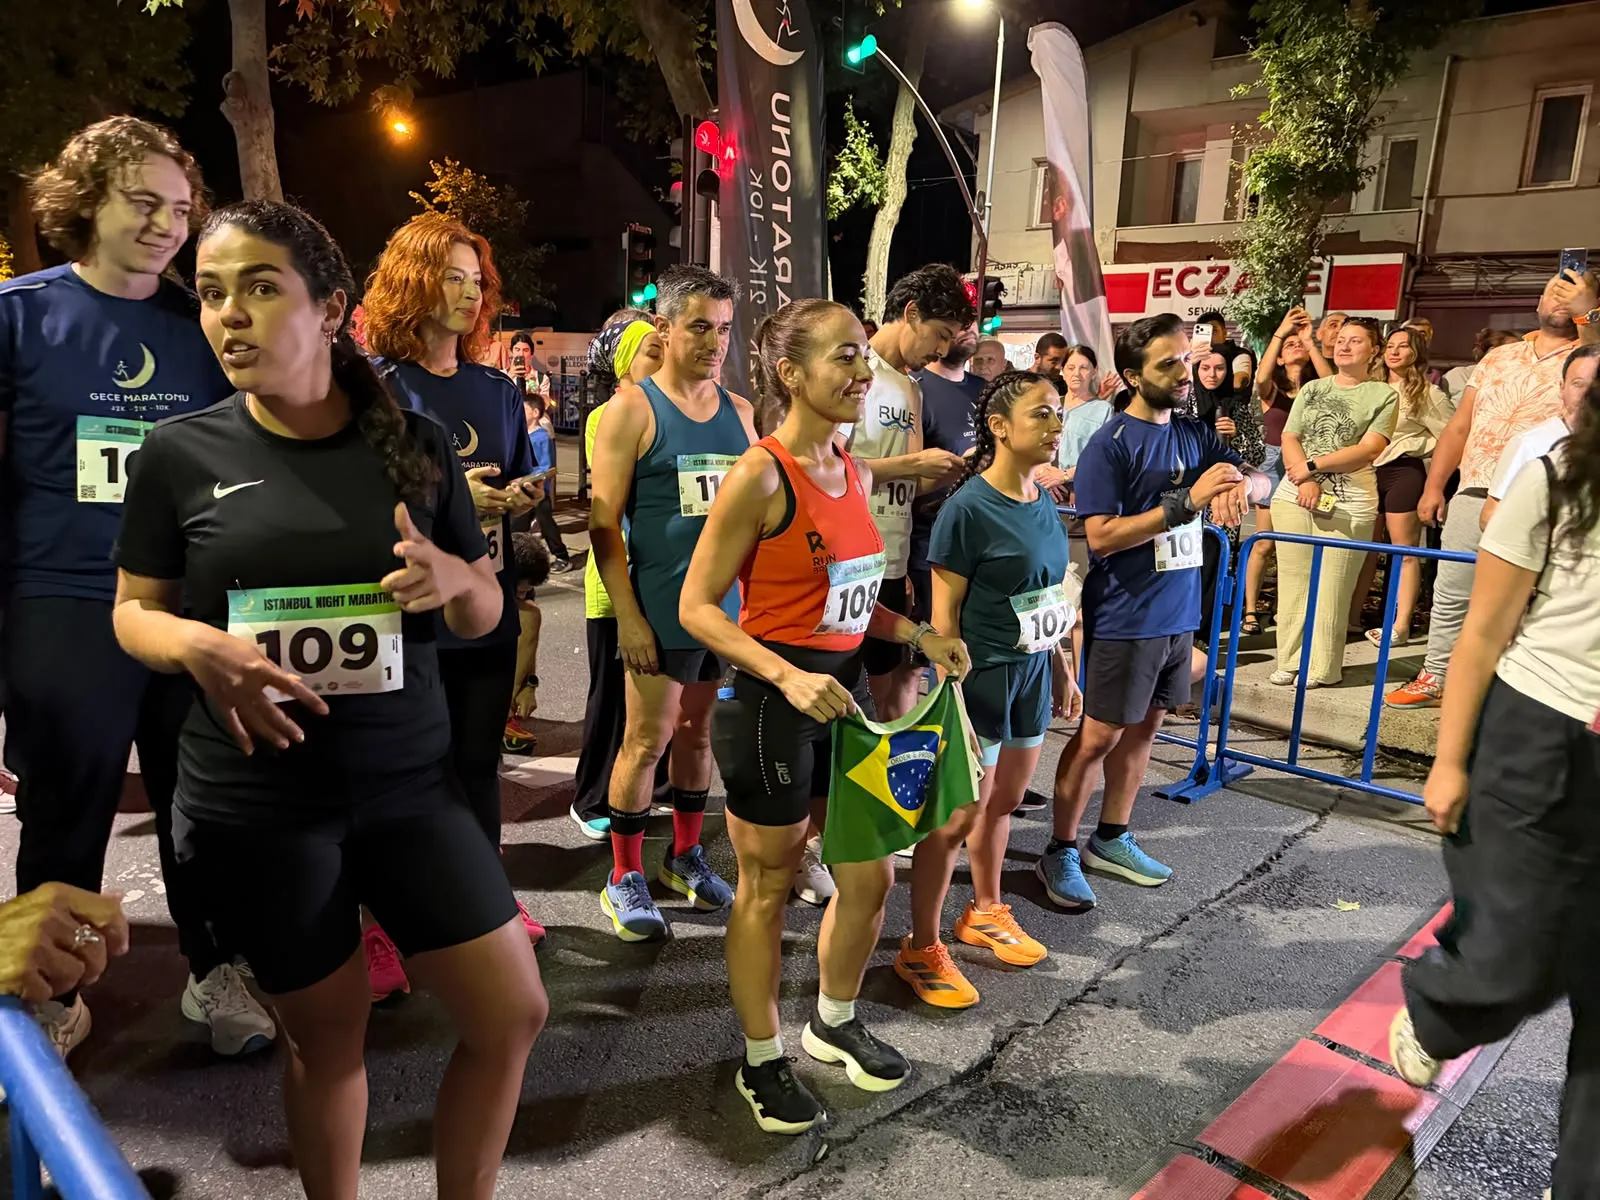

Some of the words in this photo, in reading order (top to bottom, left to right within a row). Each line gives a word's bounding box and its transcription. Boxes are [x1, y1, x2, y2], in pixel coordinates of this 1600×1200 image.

[1152, 262, 1324, 298] ECZAE
[90, 393, 121, 402] GECE
[123, 393, 190, 402] MARATONU
[812, 552, 837, 566] RUN
[316, 594, 345, 607] NIGHT
[838, 579, 878, 622] 108
[256, 622, 379, 674] 109
[384, 666, 392, 680] 1
